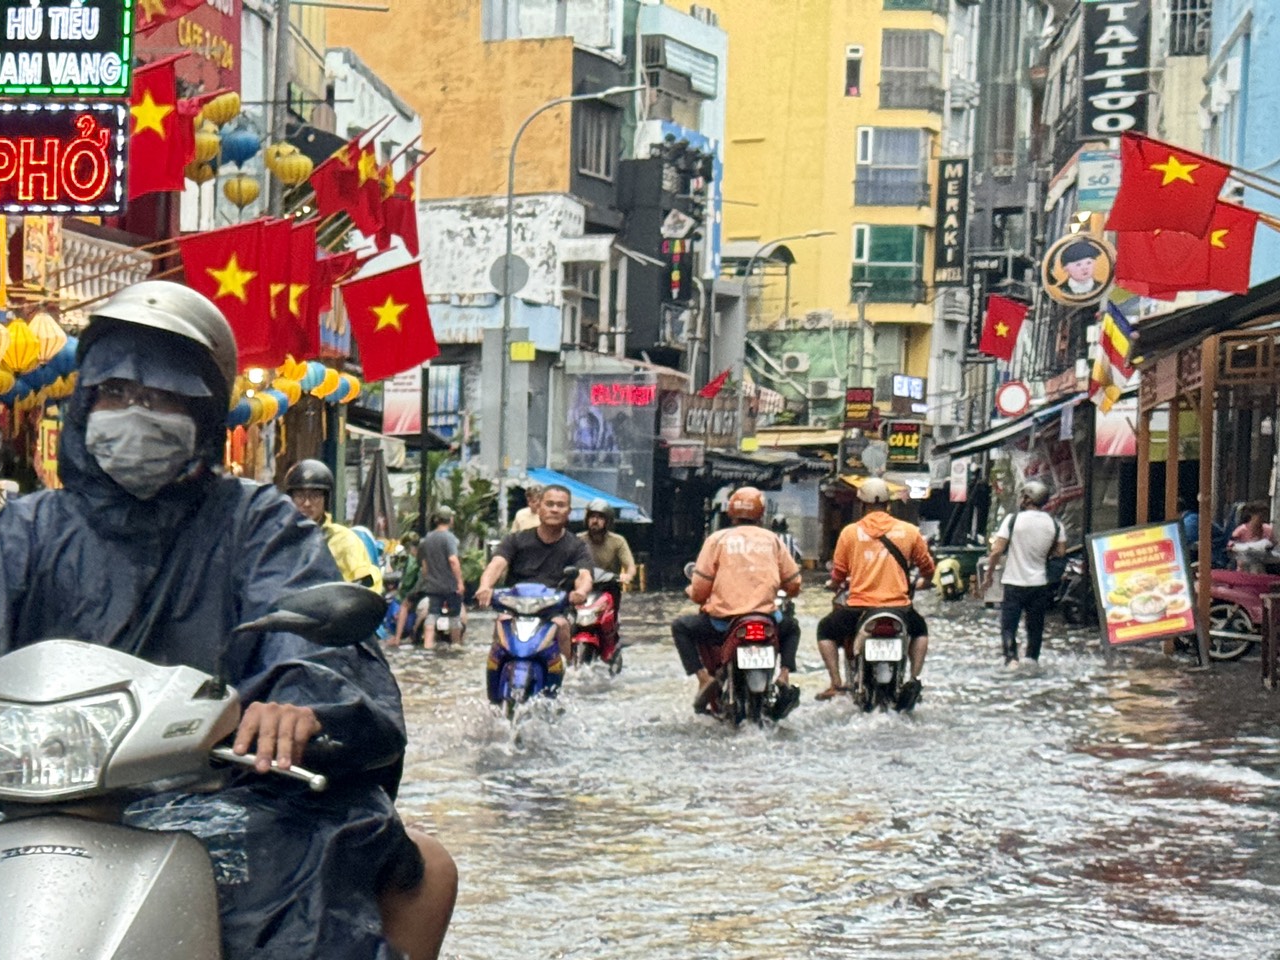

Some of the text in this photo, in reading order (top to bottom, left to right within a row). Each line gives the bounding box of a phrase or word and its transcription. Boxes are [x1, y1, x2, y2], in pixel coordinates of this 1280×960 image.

[47, 52, 122, 86] VANG
[1091, 2, 1140, 132] TATTOO
[943, 163, 964, 263] MERAKI
